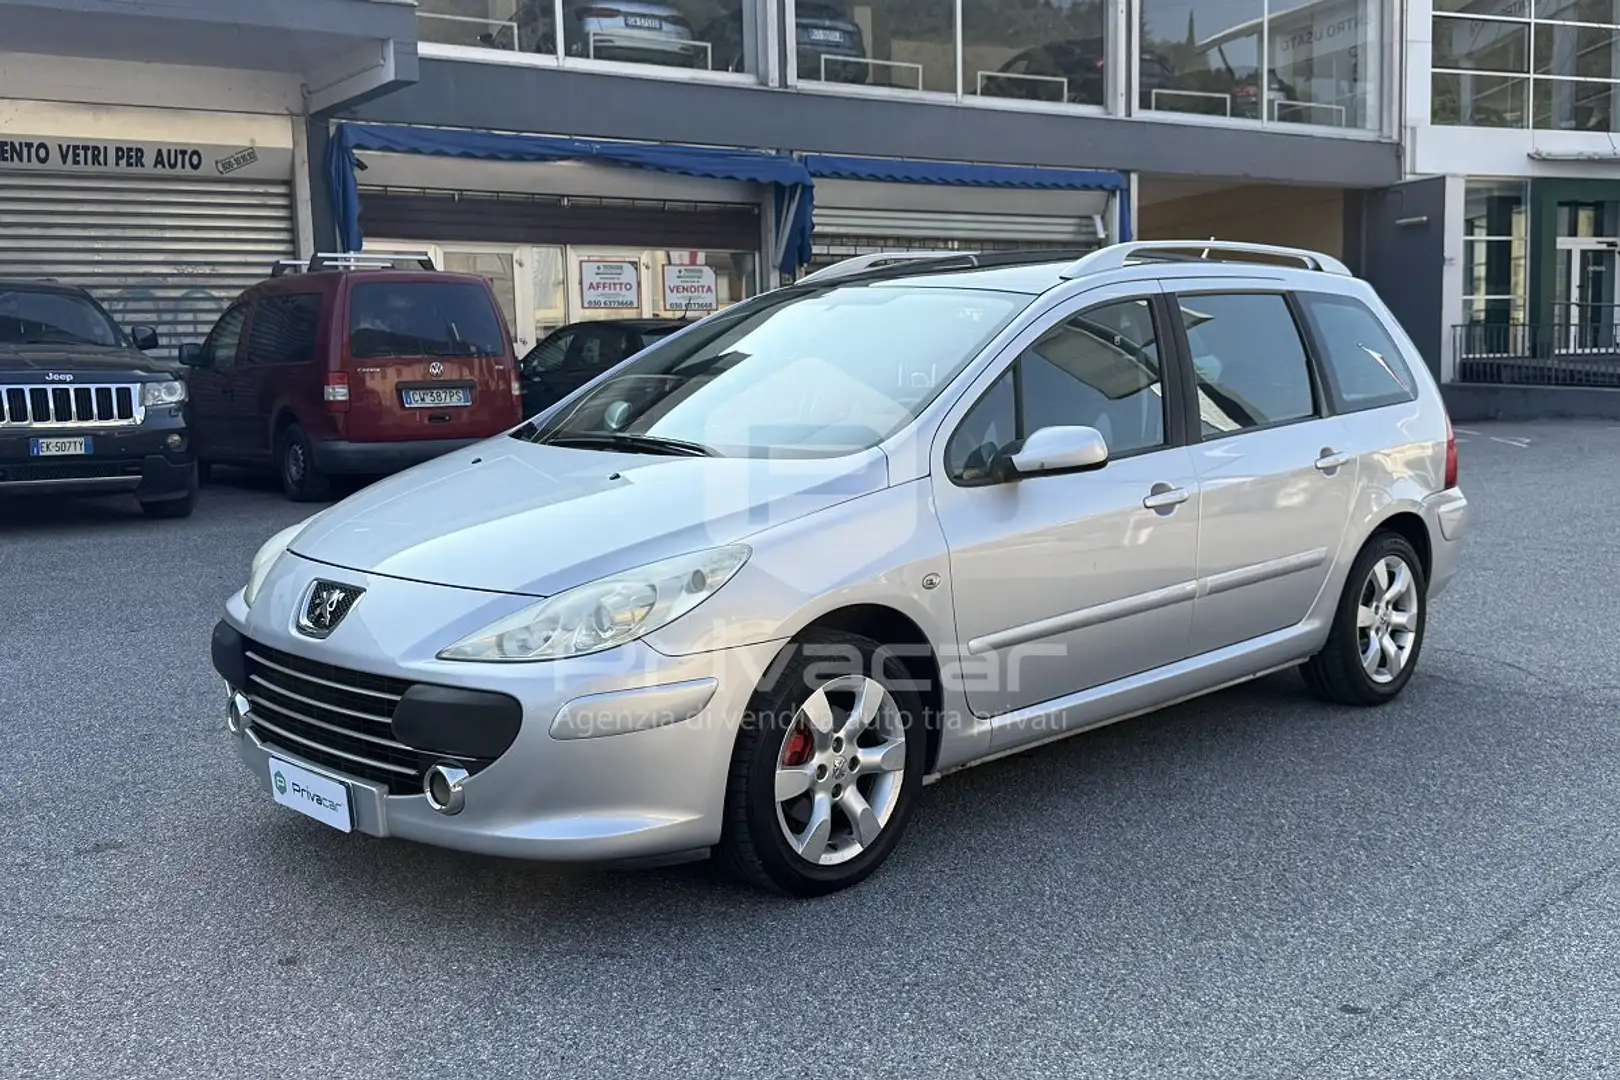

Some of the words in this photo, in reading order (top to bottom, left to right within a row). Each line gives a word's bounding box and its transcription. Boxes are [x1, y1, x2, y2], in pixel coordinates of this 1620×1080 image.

[0, 140, 50, 165] ENTO
[58, 143, 108, 167] VETRI
[115, 146, 145, 168] PER
[153, 148, 202, 171] AUTO
[587, 282, 633, 291] AFFITTO
[668, 284, 713, 294] VENDITA
[45, 372, 74, 382] Jeep
[291, 781, 342, 812] Privacar
